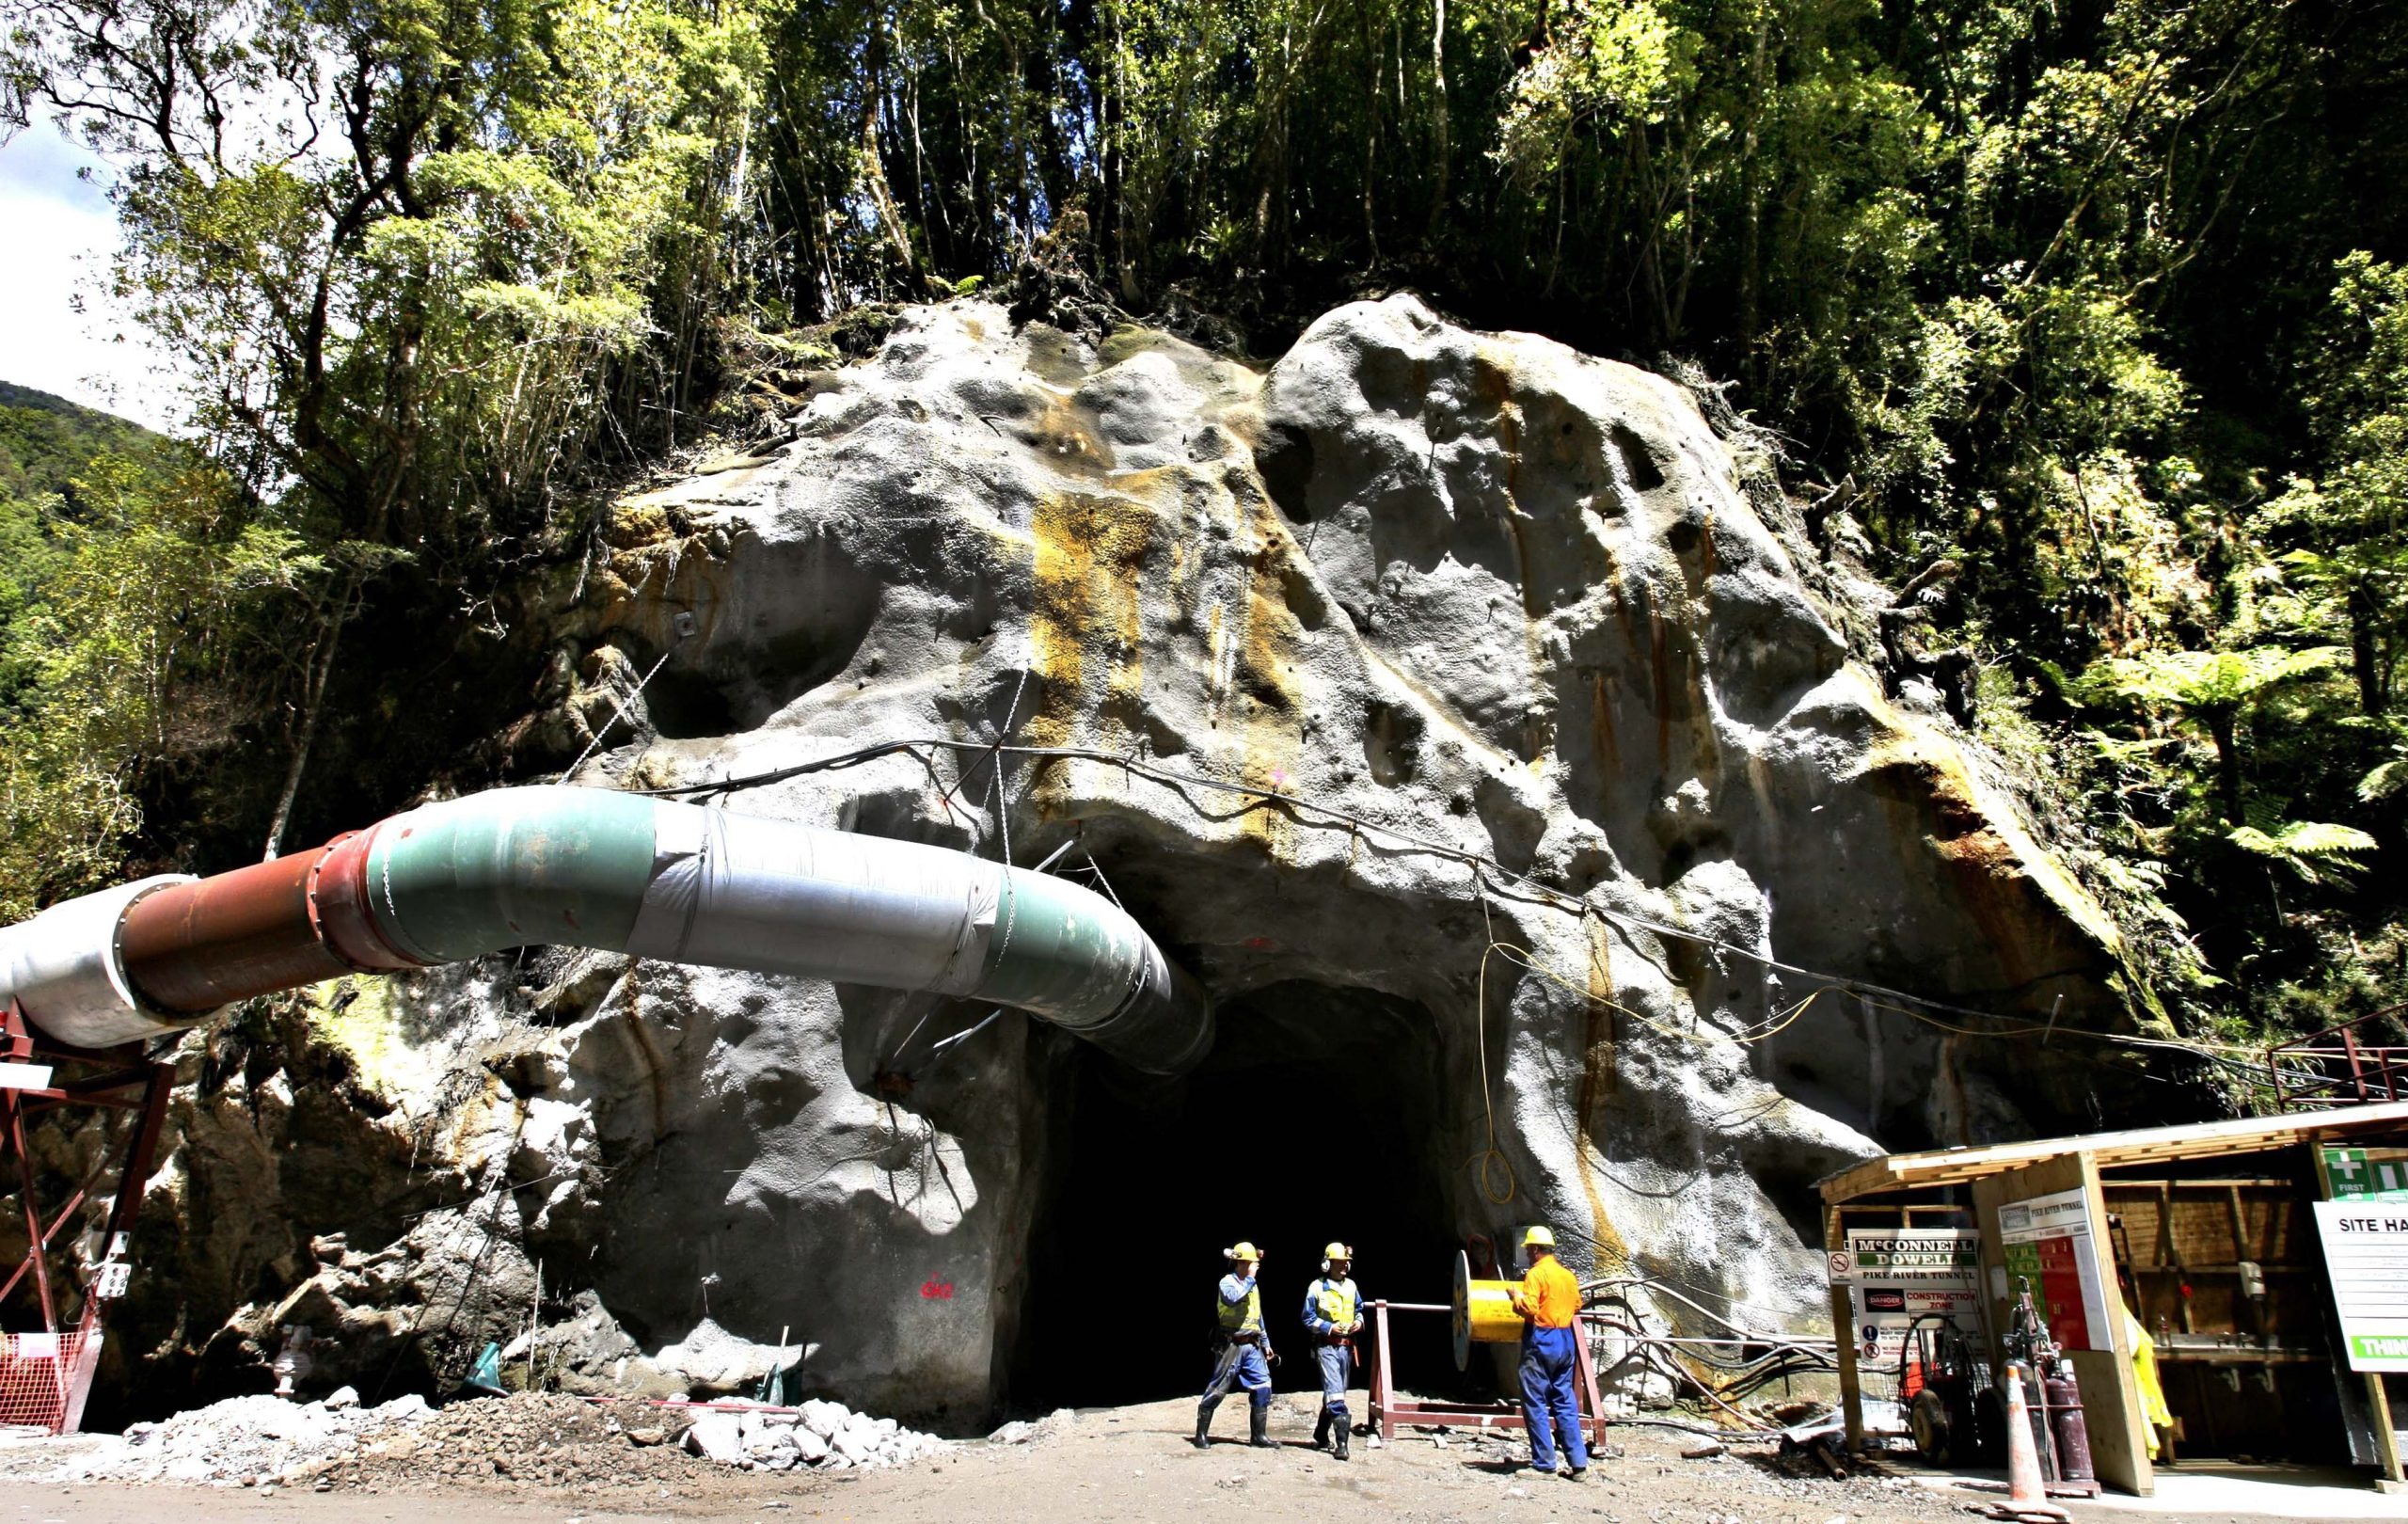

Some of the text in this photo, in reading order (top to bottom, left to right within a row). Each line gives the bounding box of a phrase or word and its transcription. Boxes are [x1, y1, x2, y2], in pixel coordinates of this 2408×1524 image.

[2338, 1183, 2365, 1192] FIRST
[2338, 1218, 2379, 1232] SITE
[1877, 1253, 1957, 1266] DOWELL
[1862, 1271, 1975, 1280] PIKE RIVER TUNNEL
[1906, 1292, 1976, 1301] CONSTRUCTION
[1929, 1301, 1956, 1310] ZONE
